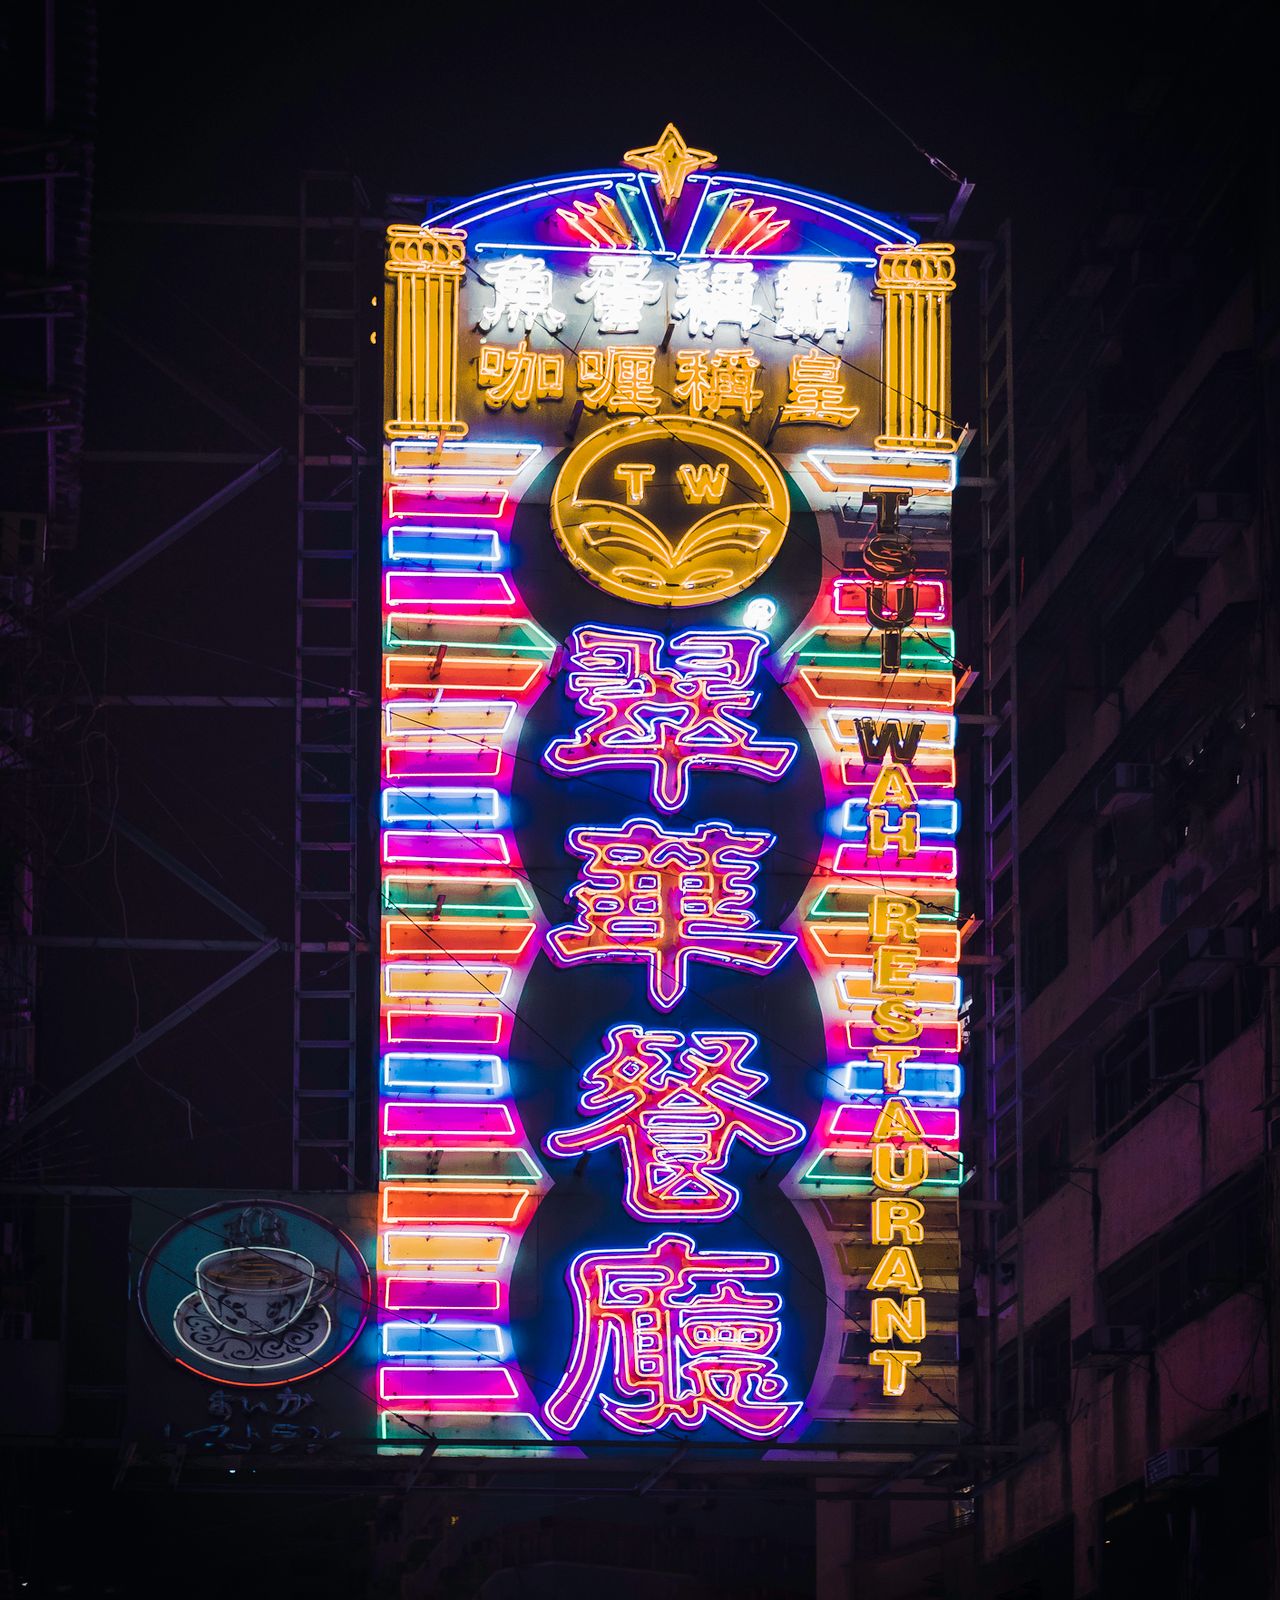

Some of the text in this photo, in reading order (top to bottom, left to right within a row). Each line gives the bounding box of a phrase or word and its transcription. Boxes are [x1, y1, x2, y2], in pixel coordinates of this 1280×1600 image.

[477, 342, 861, 428] 咖喱稱皇
[541, 624, 808, 1438] 翠華餐廳
[853, 485, 928, 1397] TSUI WAH RESTAURANT
